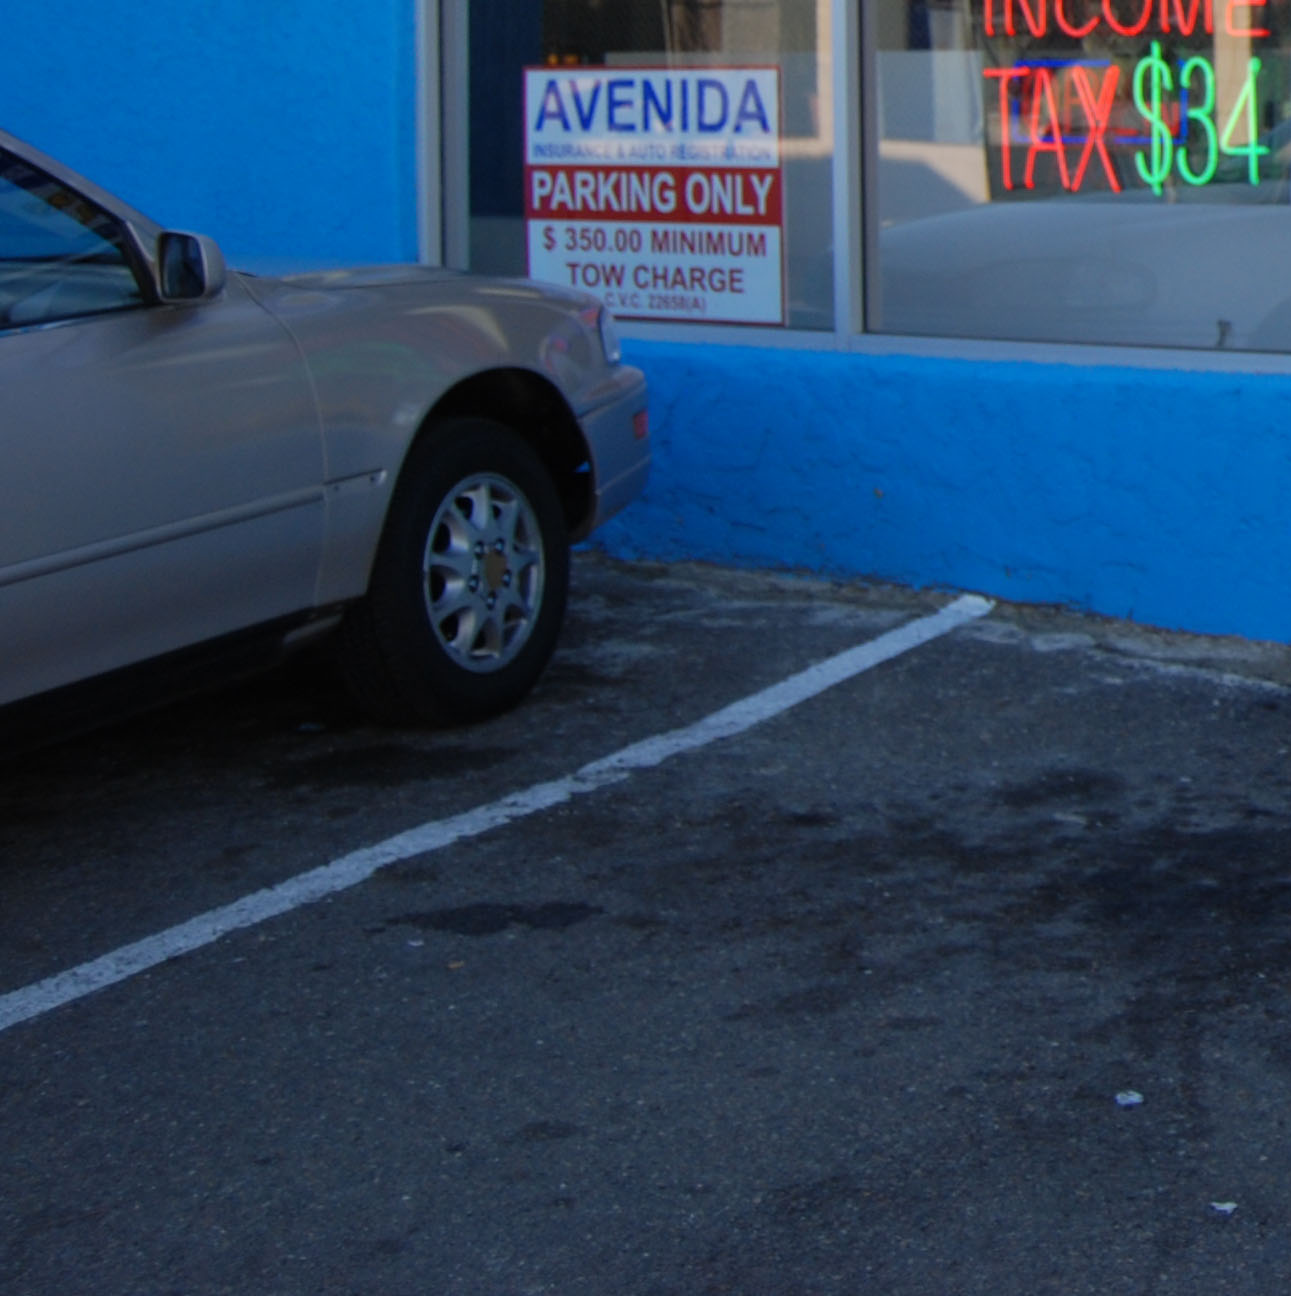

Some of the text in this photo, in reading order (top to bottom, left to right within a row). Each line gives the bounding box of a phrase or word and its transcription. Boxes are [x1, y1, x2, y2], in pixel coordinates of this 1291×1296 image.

[534, 77, 770, 135] AVENIDA
[982, 40, 1270, 197] TAX $34
[531, 169, 773, 216] PARKING ONLY
[542, 225, 766, 257] $ 350.00 MINIMUM
[566, 262, 745, 293] TOW CHARGE
